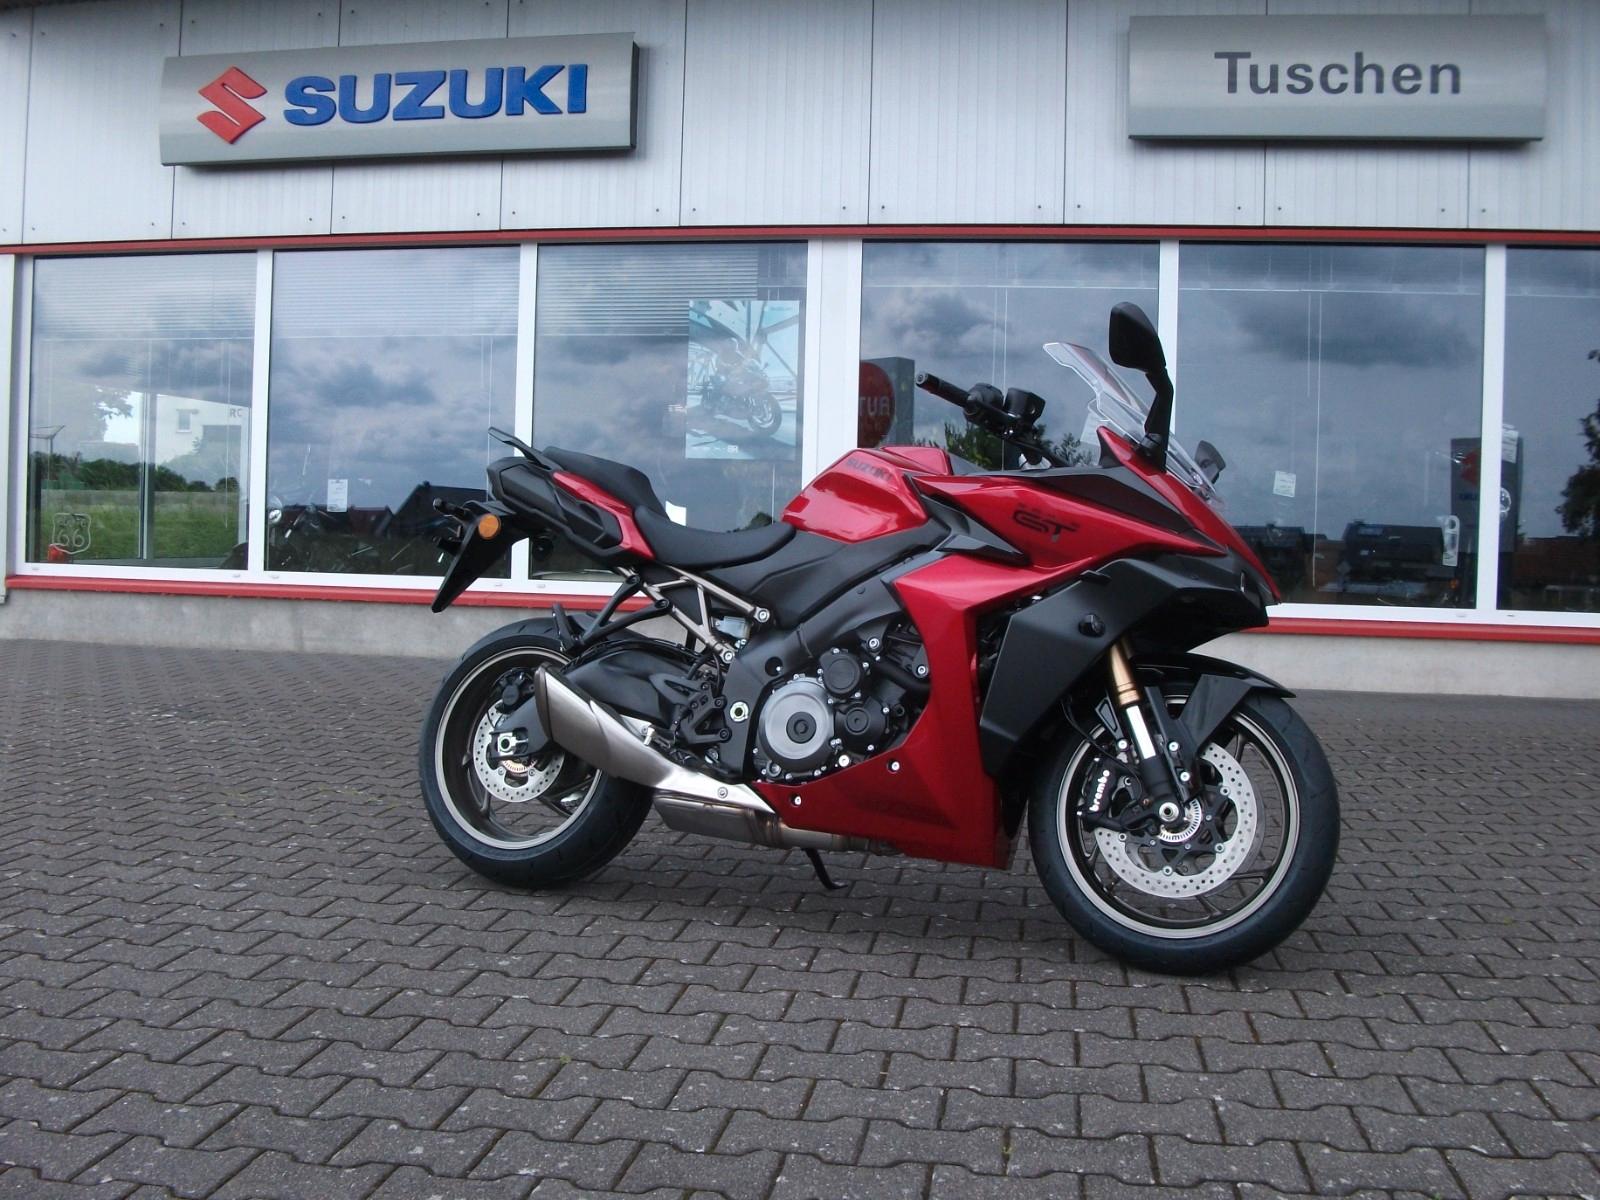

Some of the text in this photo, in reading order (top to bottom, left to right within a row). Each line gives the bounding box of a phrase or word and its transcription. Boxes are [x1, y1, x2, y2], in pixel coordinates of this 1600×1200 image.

[1214, 51, 1461, 94] Tuschen
[284, 63, 588, 126] SUZUKI
[1012, 507, 1078, 541] GT
[1089, 769, 1110, 812] brembo
